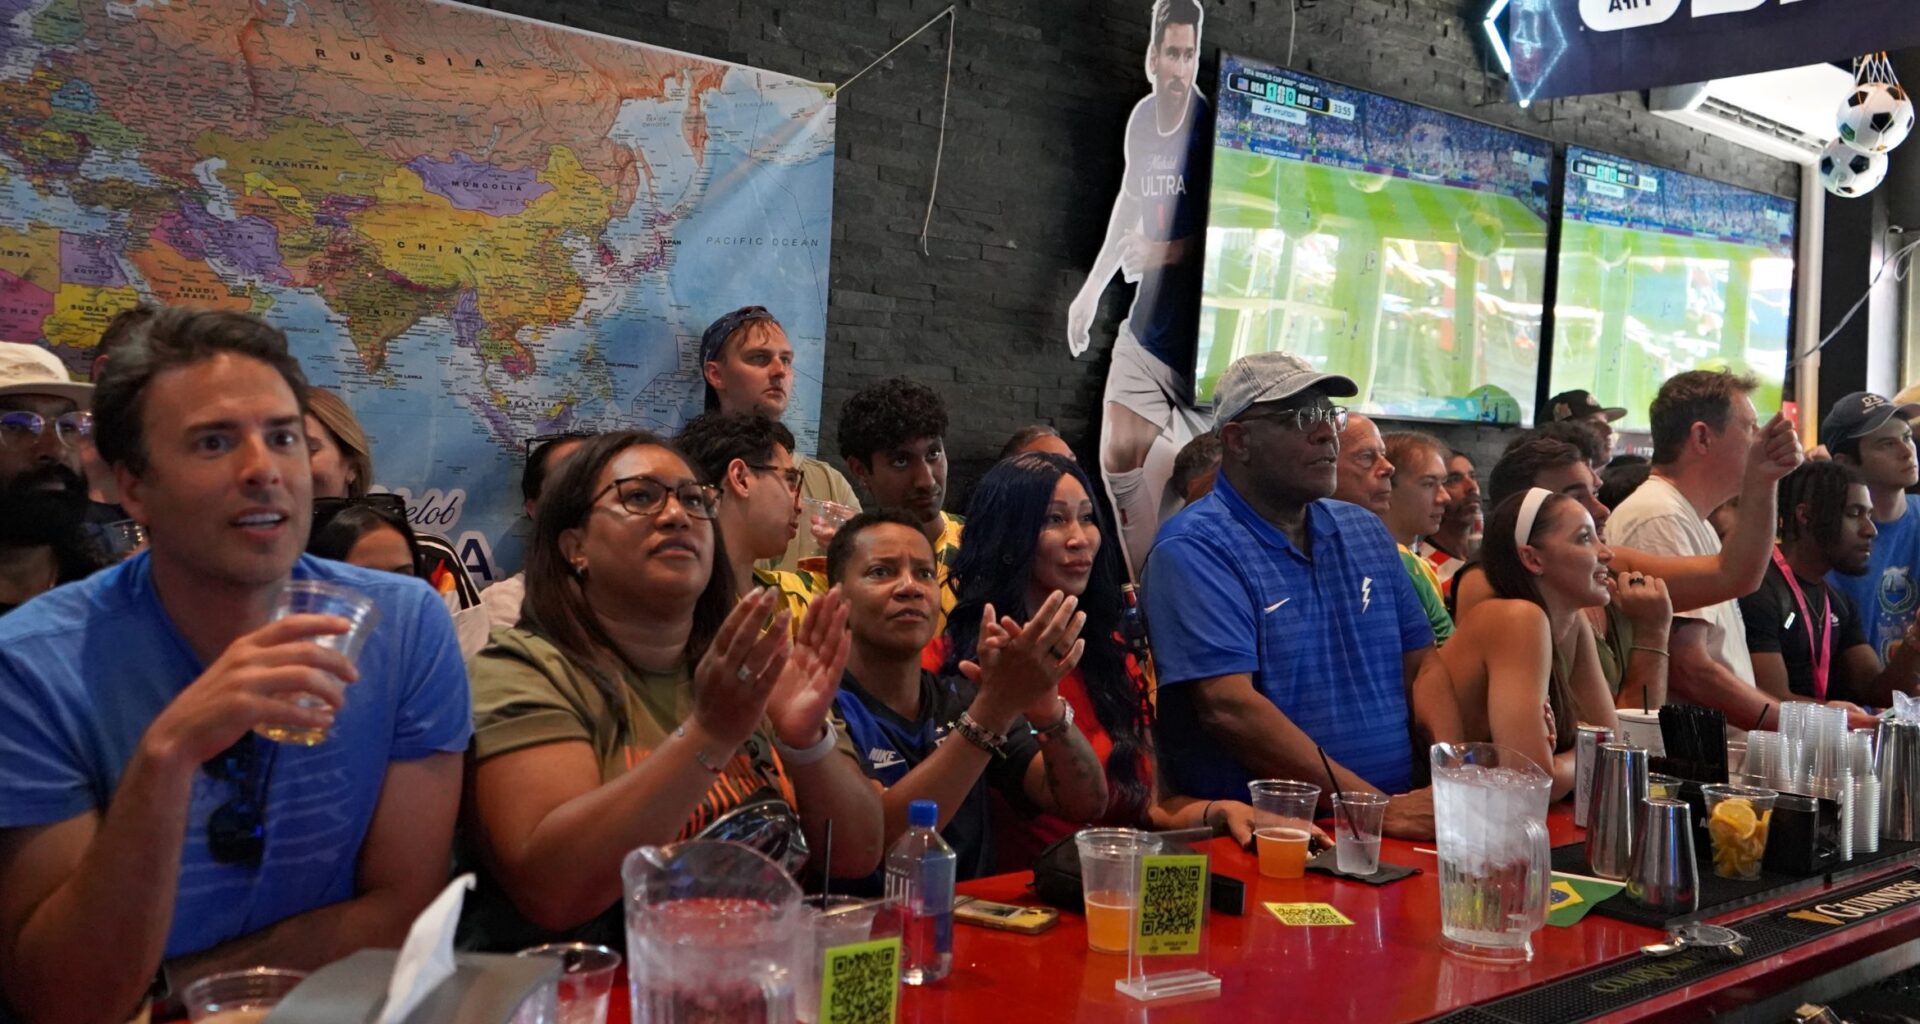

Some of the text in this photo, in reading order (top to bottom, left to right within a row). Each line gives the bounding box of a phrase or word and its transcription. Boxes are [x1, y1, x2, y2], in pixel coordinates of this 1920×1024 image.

[315, 48, 484, 68] RUSSIA
[1250, 80, 1265, 95] USA
[1333, 103, 1352, 116] 33:55
[250, 158, 329, 171] KAZAKHSTAN
[451, 180, 523, 192] MONGOLIA
[1141, 174, 1187, 197] ULTRA
[219, 231, 254, 240] IRAN
[706, 236, 819, 248] PACIFIC OCEAN
[0, 249, 30, 258] IBYA
[397, 241, 480, 257] CHINA
[74, 267, 106, 276] EGYPT
[179, 285, 215, 294] SAUDI
[175, 292, 219, 301] ARABIA
[70, 304, 109, 313] SUDAN
[366, 309, 407, 317] INDIA
[405, 496, 459, 525] elob
[868, 747, 897, 763] NIKE
